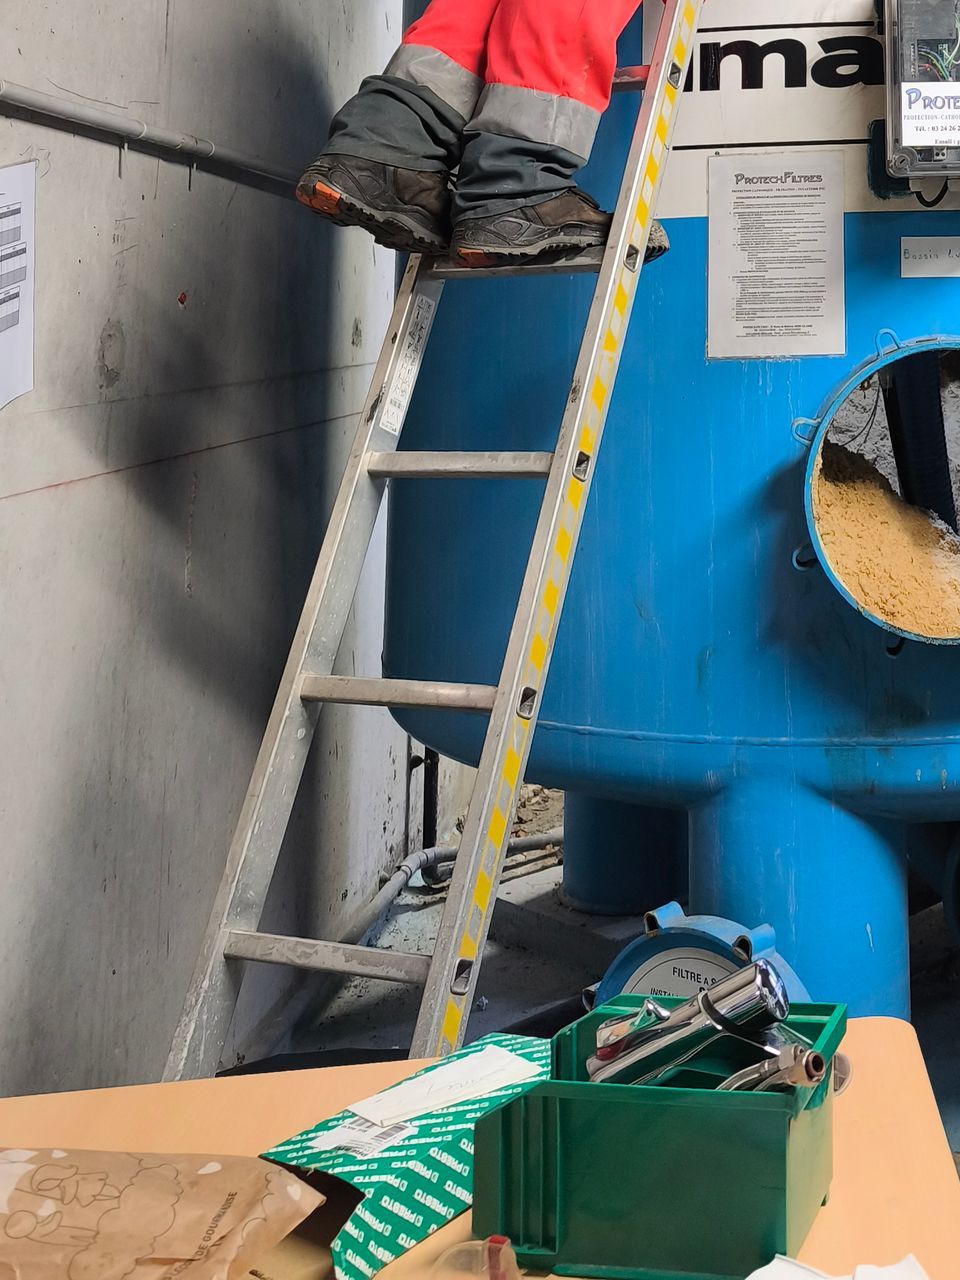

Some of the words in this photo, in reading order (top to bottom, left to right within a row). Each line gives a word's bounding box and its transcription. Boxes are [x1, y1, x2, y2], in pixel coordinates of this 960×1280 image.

[672, 966, 702, 984] FILTRE
[429, 1147, 464, 1173] PRESTO
[381, 1196, 418, 1223] PRESTO
[414, 1189, 449, 1216] PRESTO
[196, 1243, 208, 1256] DE
